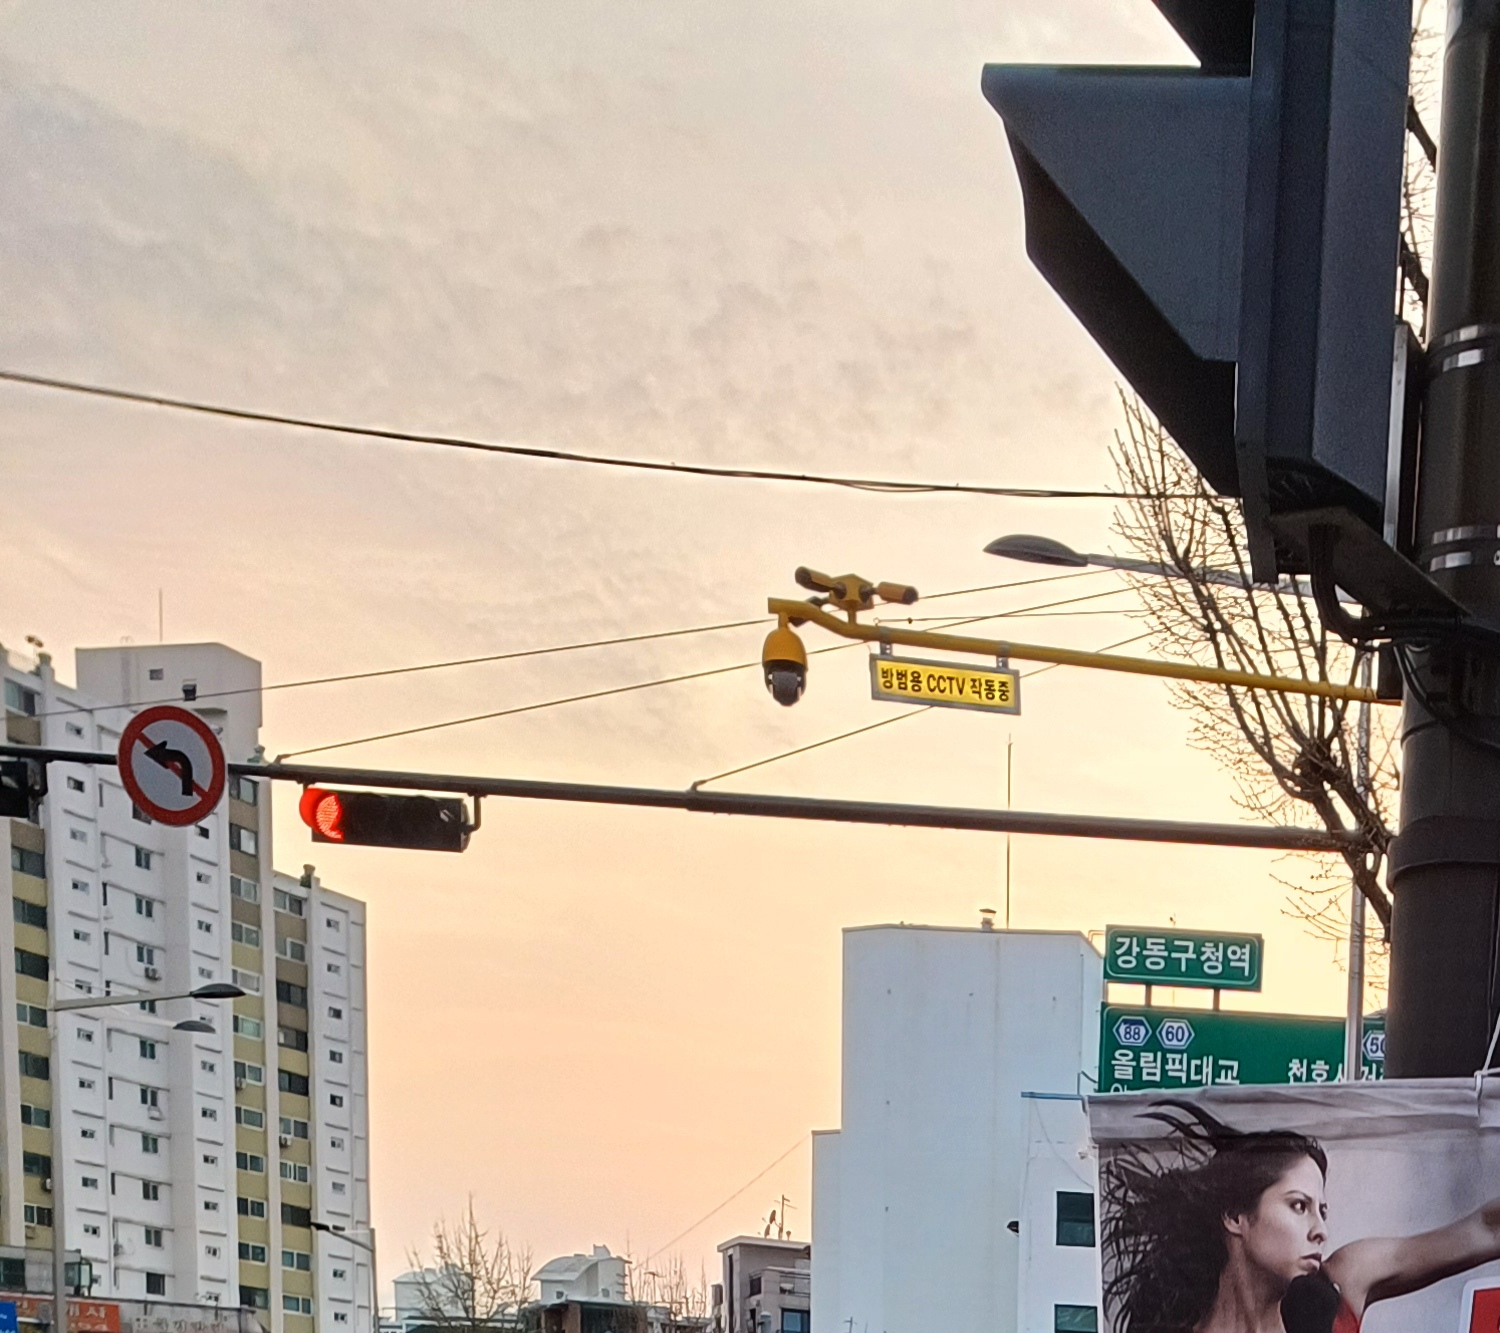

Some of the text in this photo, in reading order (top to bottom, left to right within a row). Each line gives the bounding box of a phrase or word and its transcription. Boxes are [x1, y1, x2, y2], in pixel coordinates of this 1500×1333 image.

[881, 667, 1011, 702] 방범용 CCTV 작동중
[1114, 936, 1251, 977] 강동구청역
[1123, 1024, 1184, 1043] 88 60
[1110, 1048, 1241, 1086] 올림픽대교
